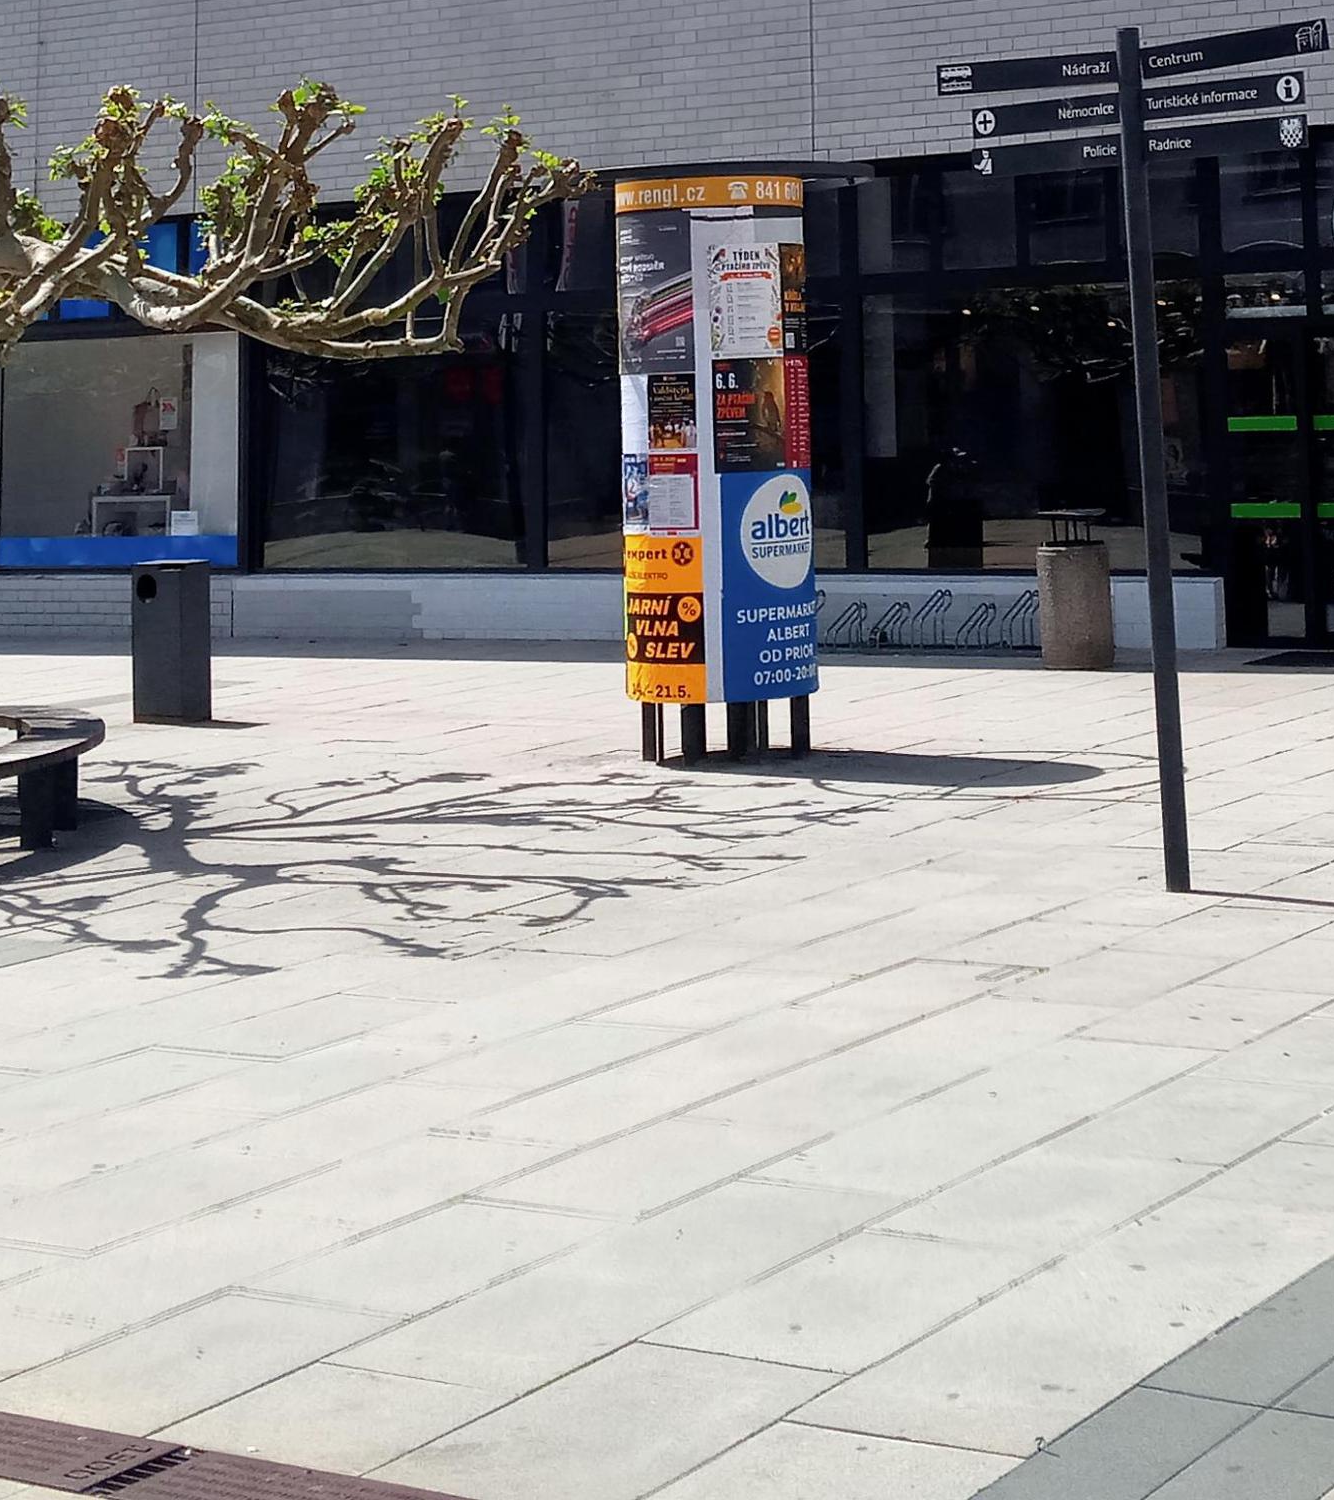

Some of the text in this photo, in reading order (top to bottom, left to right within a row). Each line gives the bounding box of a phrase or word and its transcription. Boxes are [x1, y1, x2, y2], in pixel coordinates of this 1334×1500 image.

[1148, 49, 1203, 68] Centrum
[1062, 61, 1111, 77] Nádraží
[1146, 87, 1258, 111] Turistické informace
[1058, 103, 1115, 120] Nemocnice
[1083, 144, 1117, 158] Policie
[1149, 136, 1192, 152] Radnice
[755, 182, 780, 199] 841
[732, 248, 760, 261] TÝDEN
[715, 373, 739, 389] 6. 6.
[751, 509, 810, 541] albert
[635, 619, 679, 637] VLNA
[767, 623, 810, 642] ALBERT
[645, 642, 695, 659] SLEV
[759, 649, 782, 664] OD
